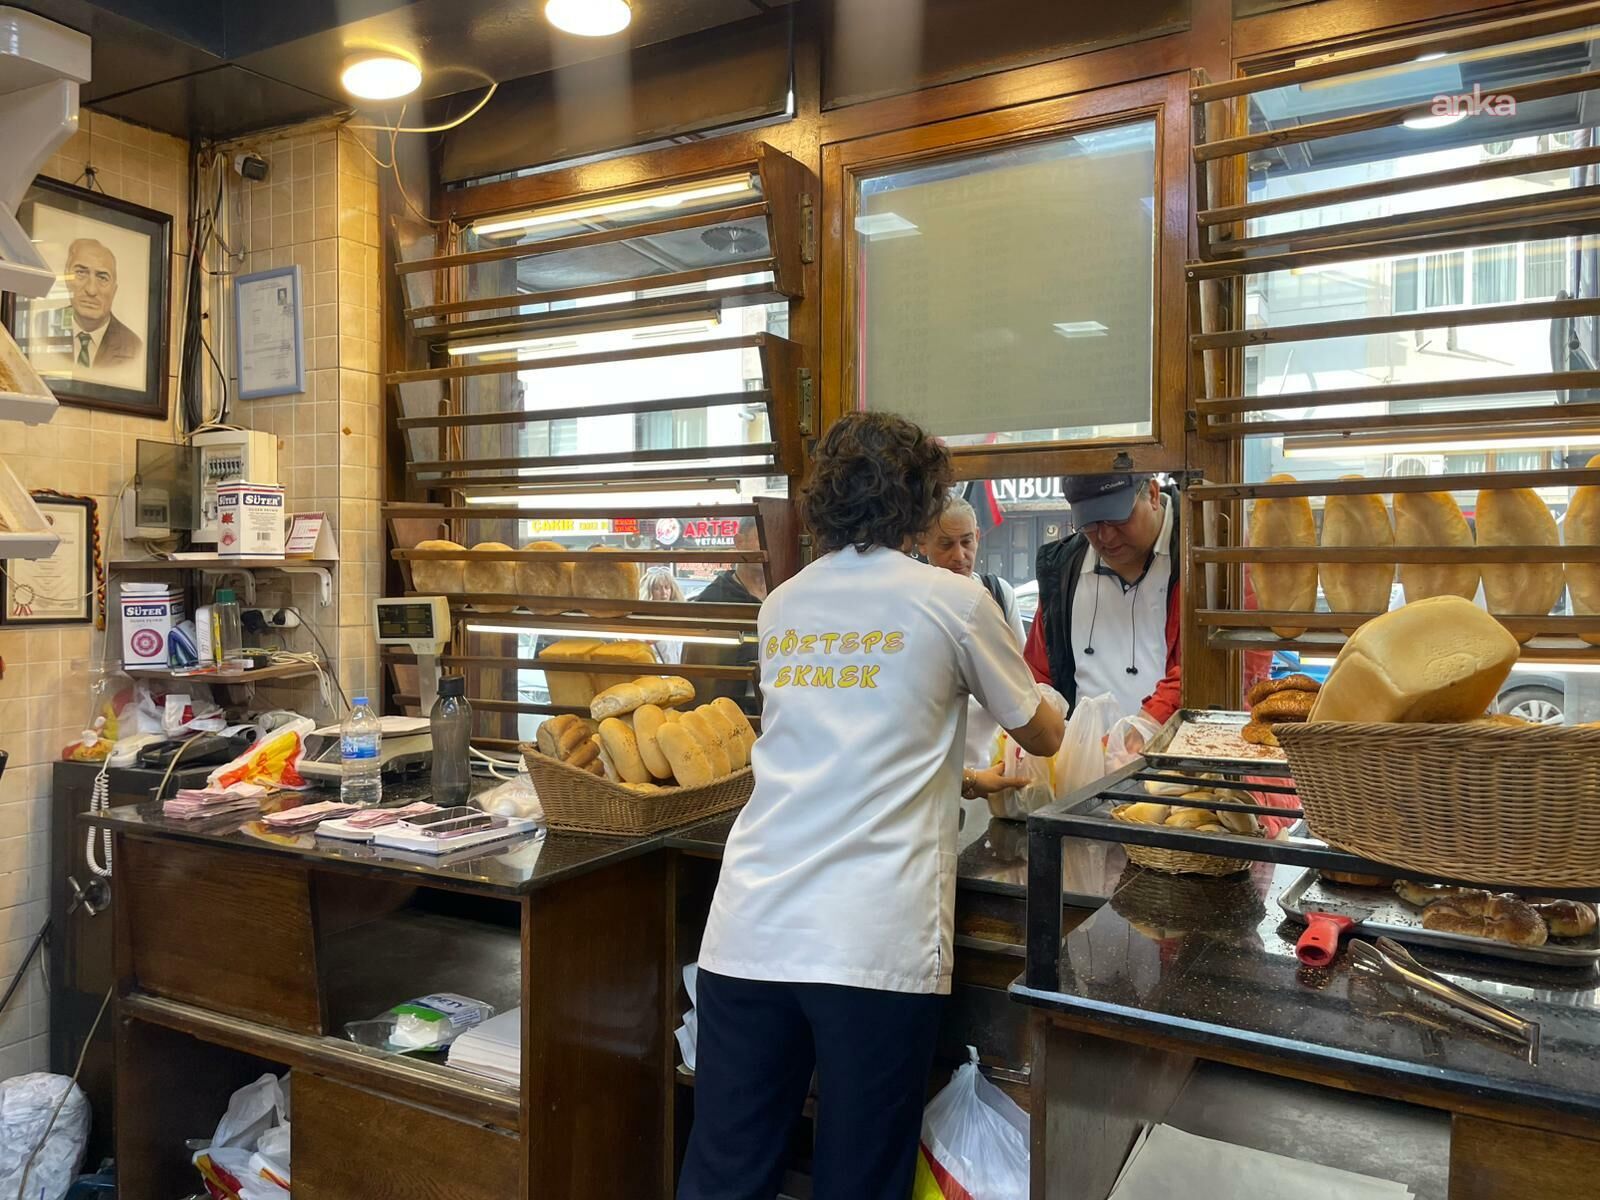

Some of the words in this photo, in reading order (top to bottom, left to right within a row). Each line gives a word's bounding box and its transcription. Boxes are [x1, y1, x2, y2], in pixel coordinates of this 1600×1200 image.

[245, 494, 278, 506] SÜTER
[126, 606, 162, 617] SÜTER
[766, 629, 905, 659] GÖZTEPE
[774, 664, 881, 689] EKMEK
